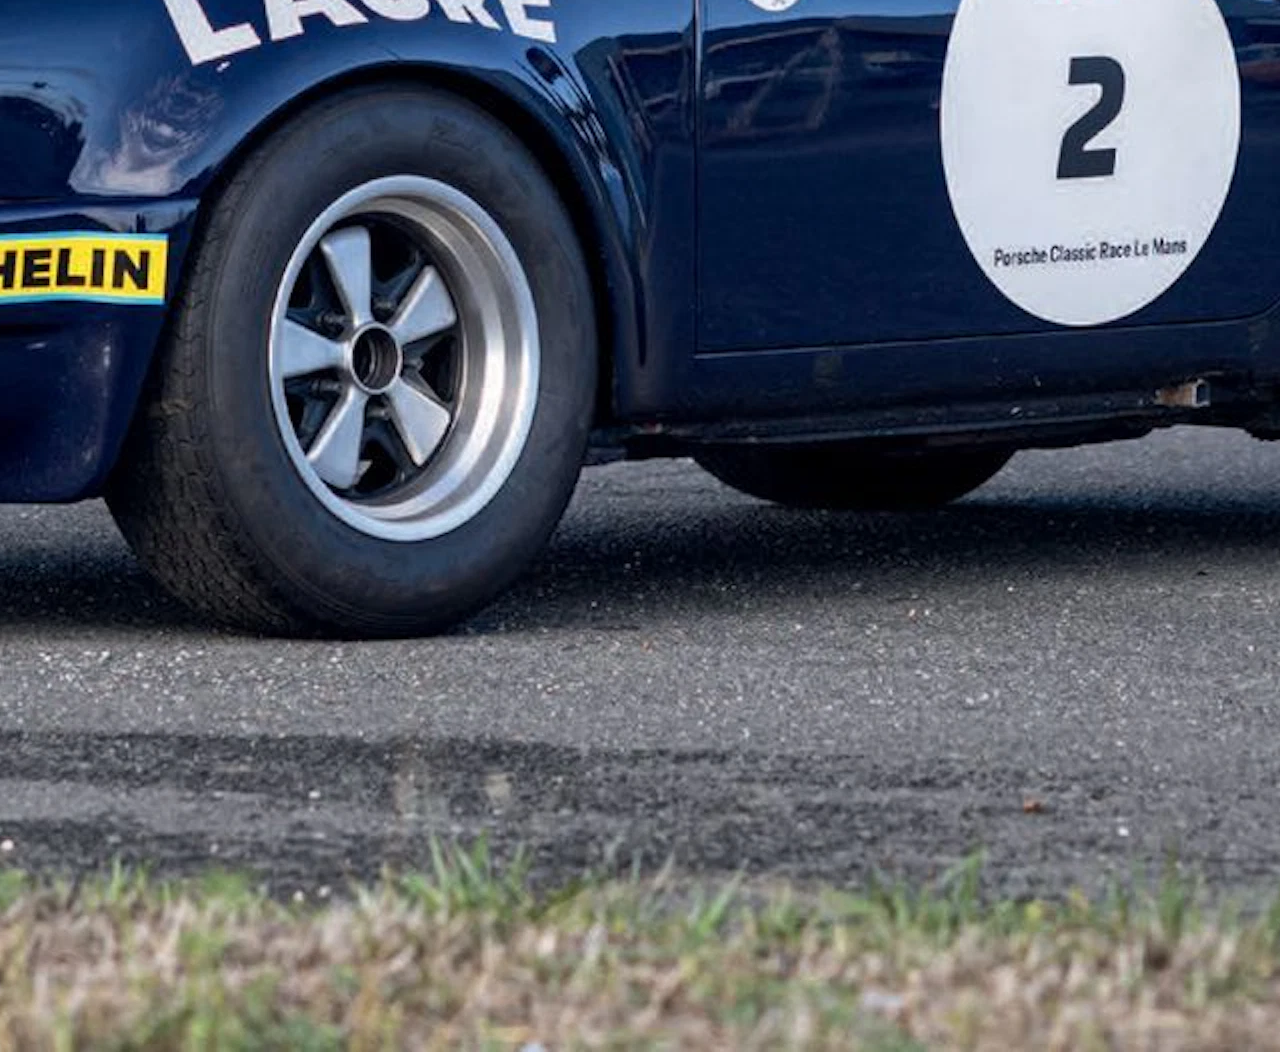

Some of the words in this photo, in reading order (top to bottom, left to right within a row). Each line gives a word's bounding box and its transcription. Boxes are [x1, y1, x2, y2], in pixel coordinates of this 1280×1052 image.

[1056, 55, 1126, 180] 2
[994, 248, 1048, 266] Porsche
[1050, 244, 1096, 263] Classic
[1099, 242, 1131, 260] Race
[1135, 240, 1149, 256] Le
[1153, 237, 1187, 255] Mans
